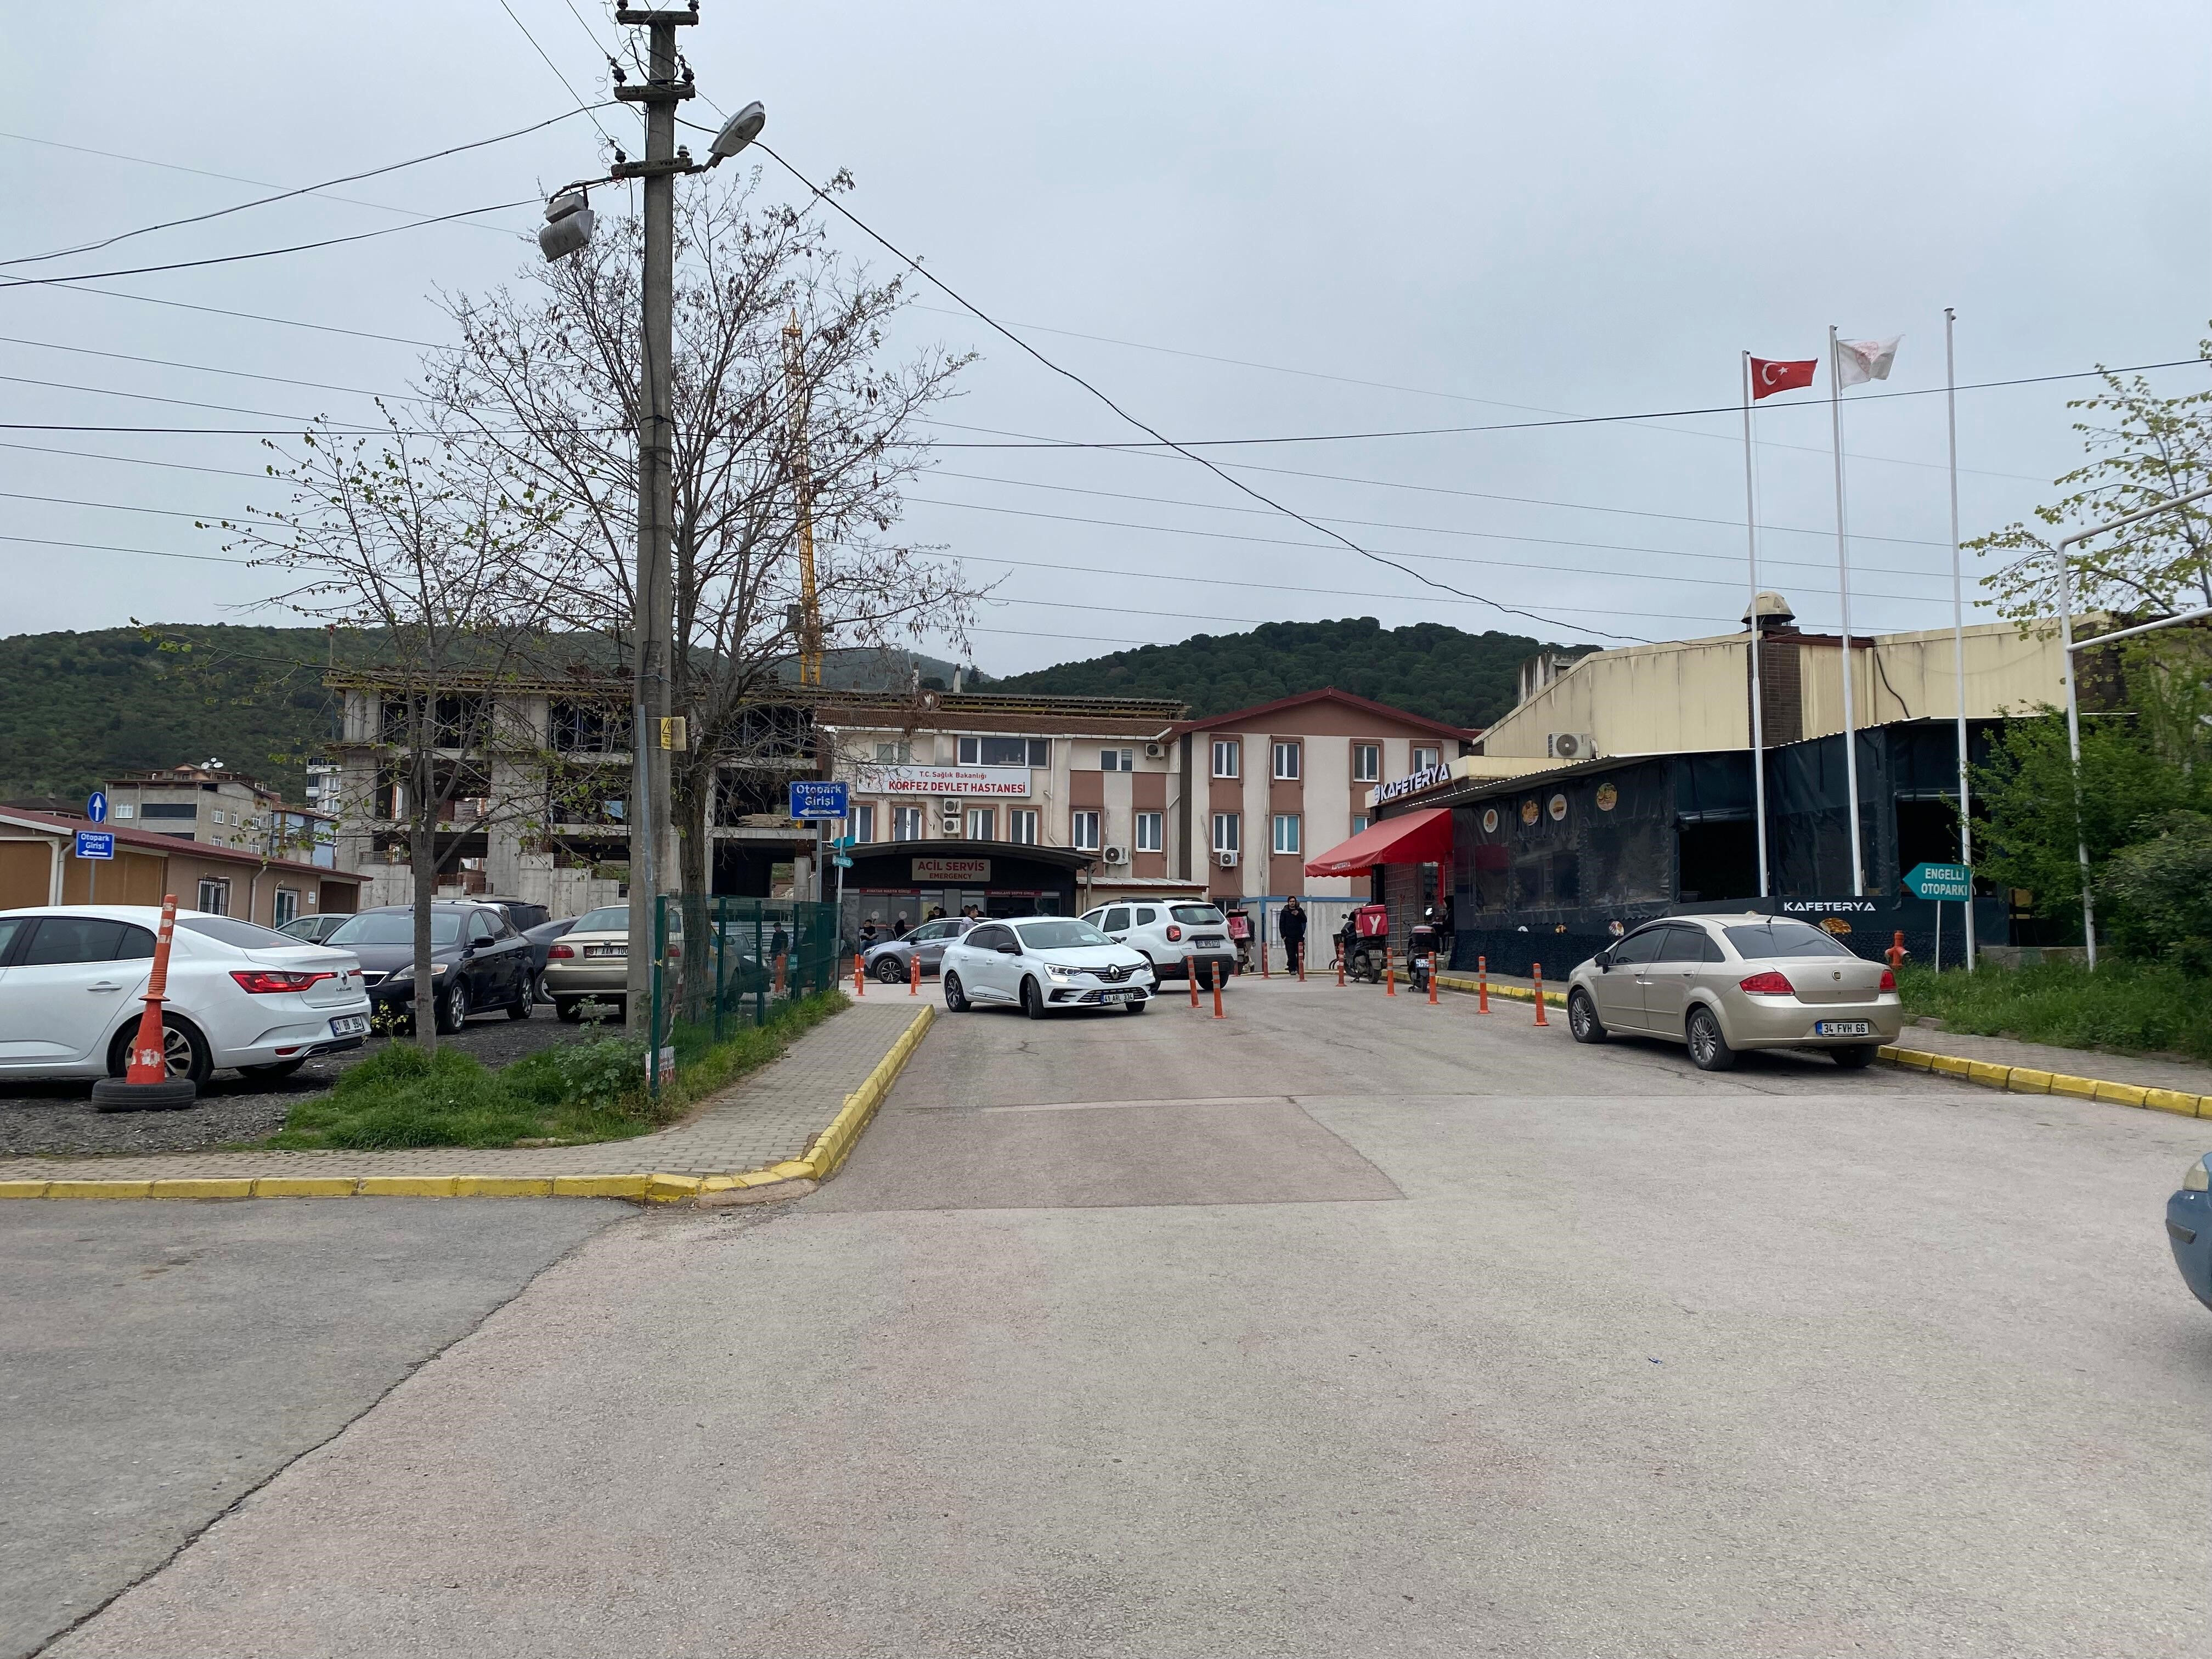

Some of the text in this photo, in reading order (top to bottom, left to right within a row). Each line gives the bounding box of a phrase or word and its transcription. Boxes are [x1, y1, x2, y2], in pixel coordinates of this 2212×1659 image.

[889, 778, 1025, 793] KÖRFEZ DEVLET HASTANESİ
[1381, 763, 1449, 801] KAFETERYA
[796, 785, 842, 794] Otopark
[804, 796, 834, 806] Girişi
[81, 833, 110, 842] Otopark
[918, 860, 984, 871] ACİL SERVİS
[1925, 867, 1964, 881] ENGELLİ
[1921, 883, 1967, 895] OTOPARKI
[1784, 902, 1876, 911] KAFETERYA
[1824, 1024, 1865, 1033] 34 FVH 66
